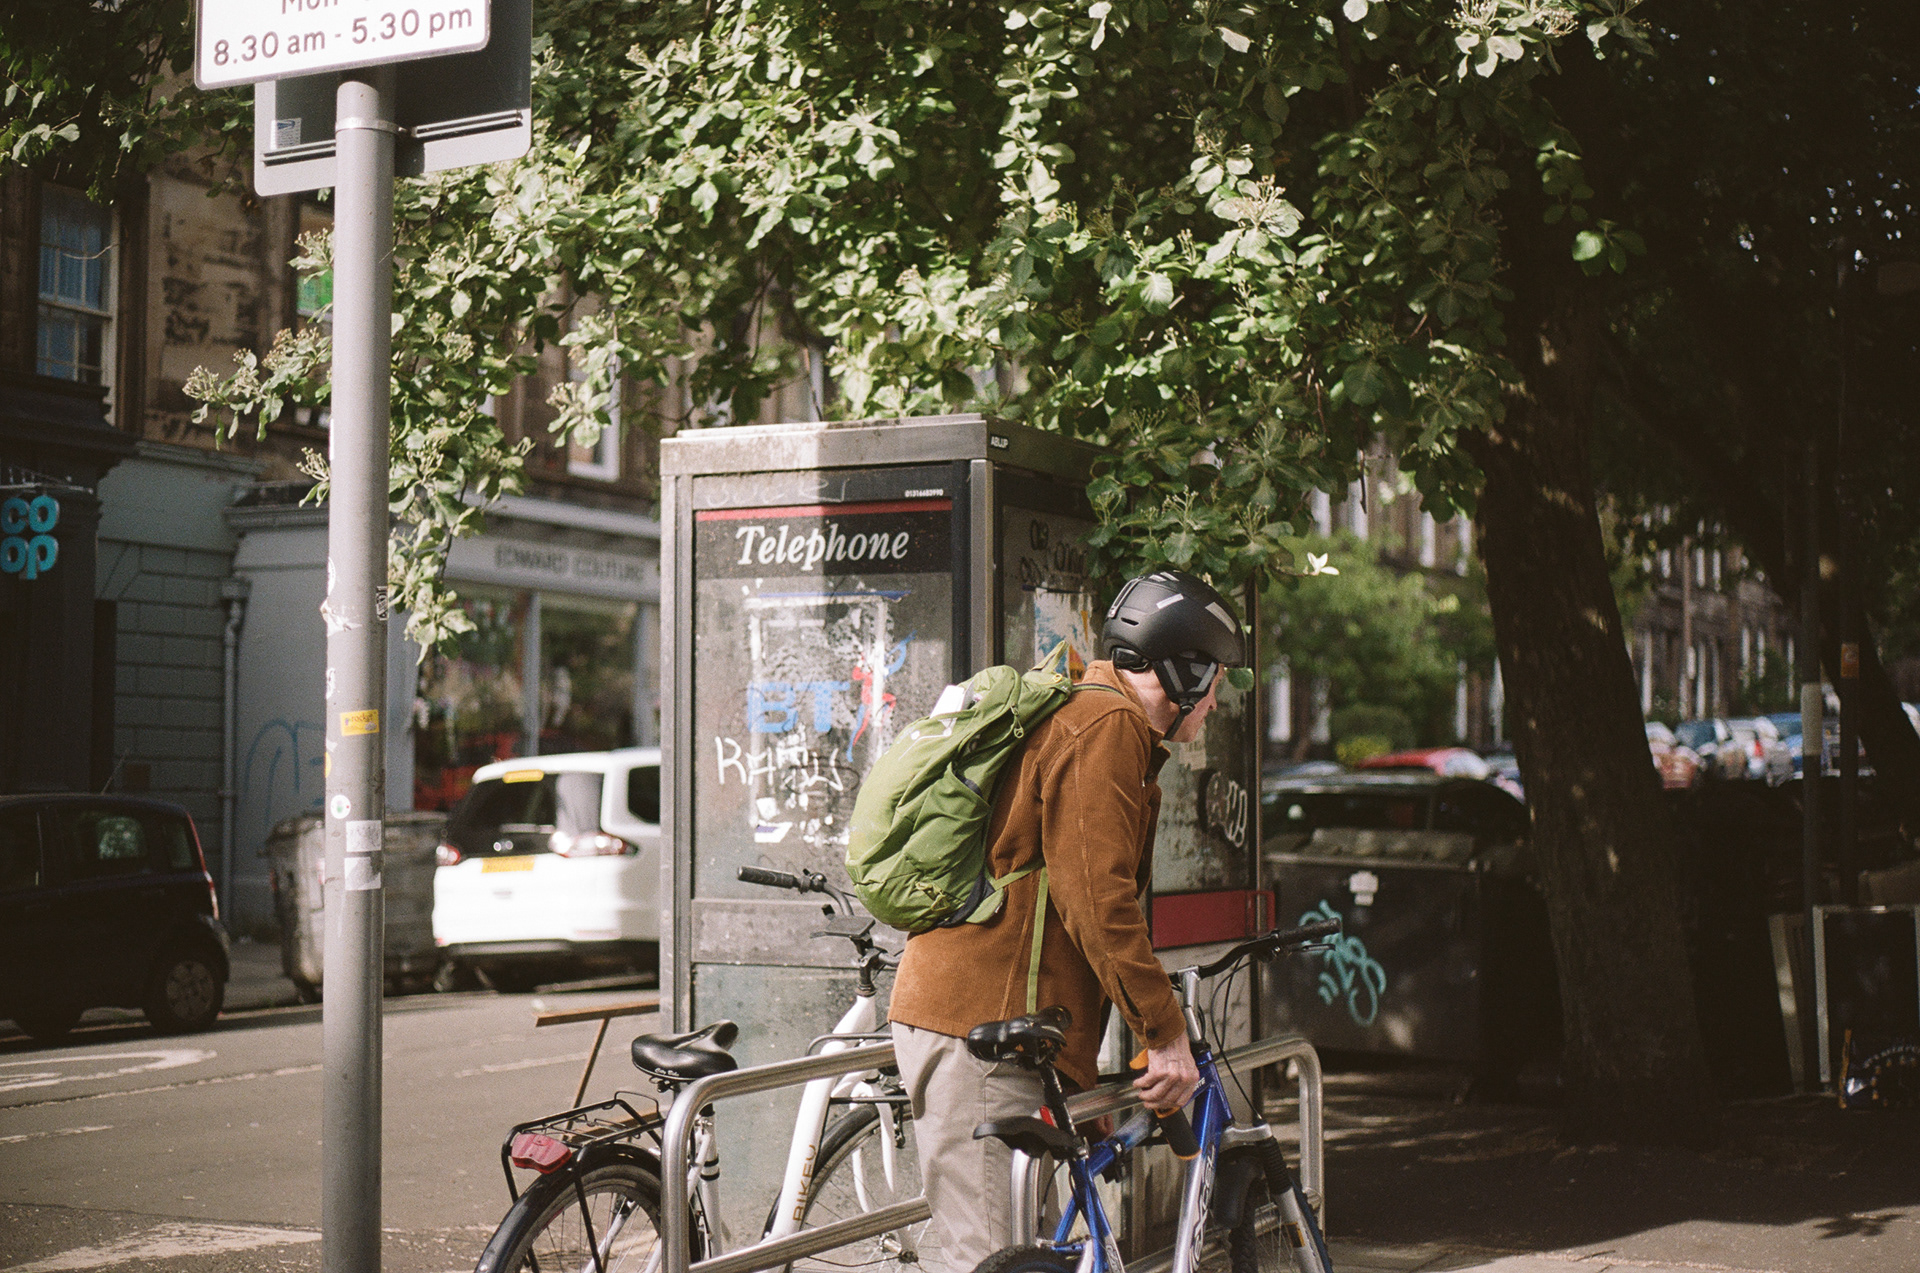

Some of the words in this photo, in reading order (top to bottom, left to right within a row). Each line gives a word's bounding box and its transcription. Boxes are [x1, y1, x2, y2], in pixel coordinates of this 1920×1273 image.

[213, 31, 279, 66] 8.30
[287, 30, 325, 54] am
[352, 9, 420, 44] 5.30
[429, 8, 472, 38] pm
[735, 523, 910, 571] Telephone
[747, 681, 849, 733] BT
